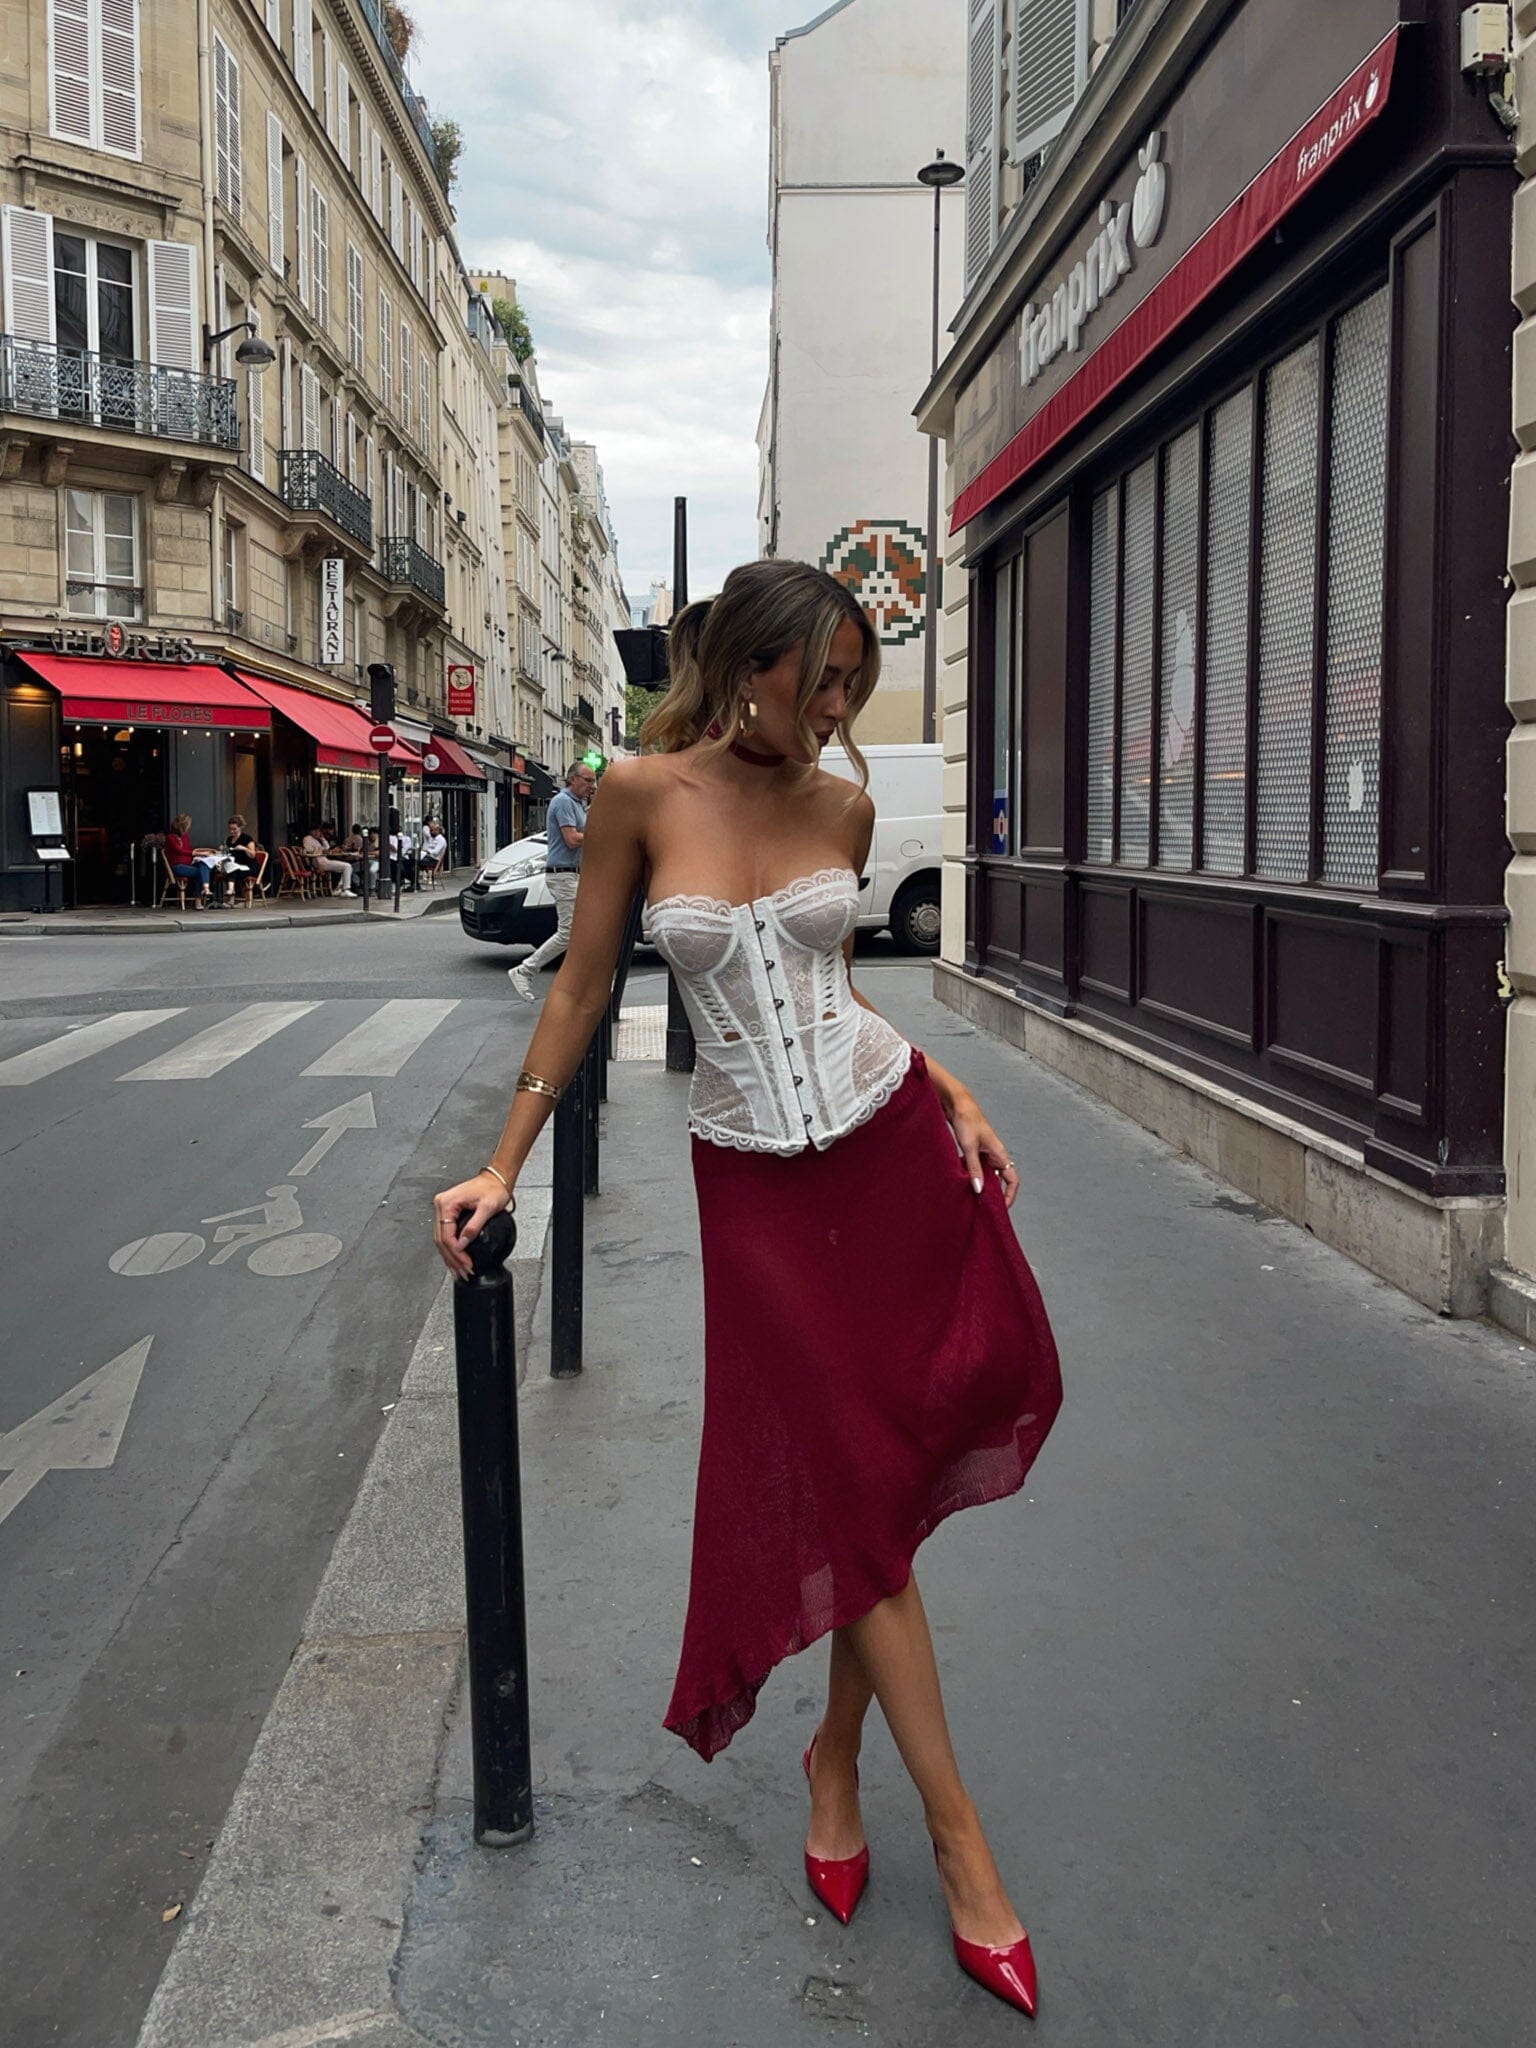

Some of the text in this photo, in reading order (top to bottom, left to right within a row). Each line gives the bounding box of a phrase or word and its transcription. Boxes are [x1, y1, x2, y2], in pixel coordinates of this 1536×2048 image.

[1297, 95, 1362, 182] franprix
[1019, 200, 1131, 387] franprix
[326, 560, 339, 662] RESTAURANT
[128, 703, 147, 719] LE
